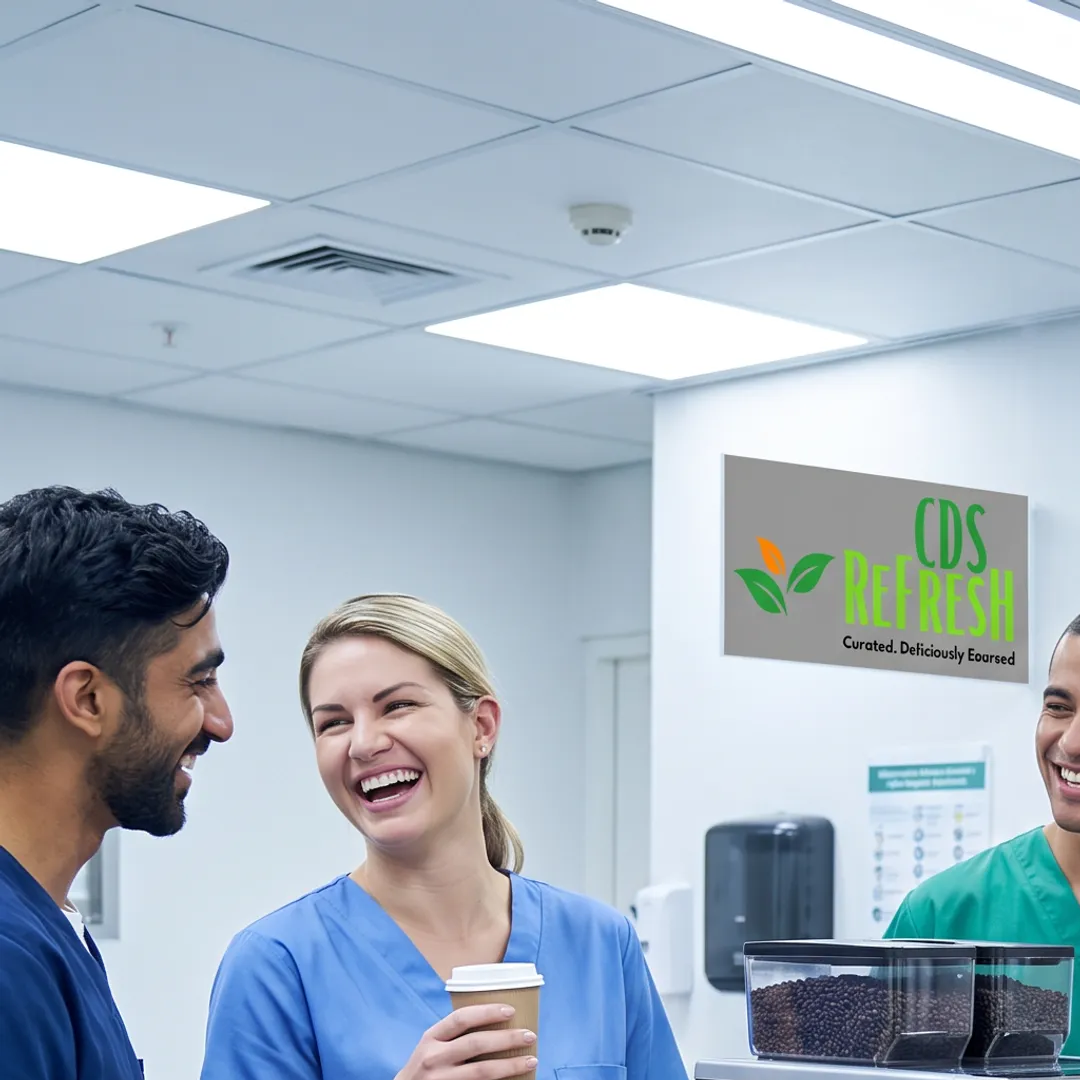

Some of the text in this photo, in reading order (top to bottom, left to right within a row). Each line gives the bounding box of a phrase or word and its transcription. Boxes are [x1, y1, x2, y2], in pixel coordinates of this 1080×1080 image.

[914, 497, 987, 574] CDS
[843, 548, 1015, 643] REFRESH
[842, 635, 897, 654] Curated.
